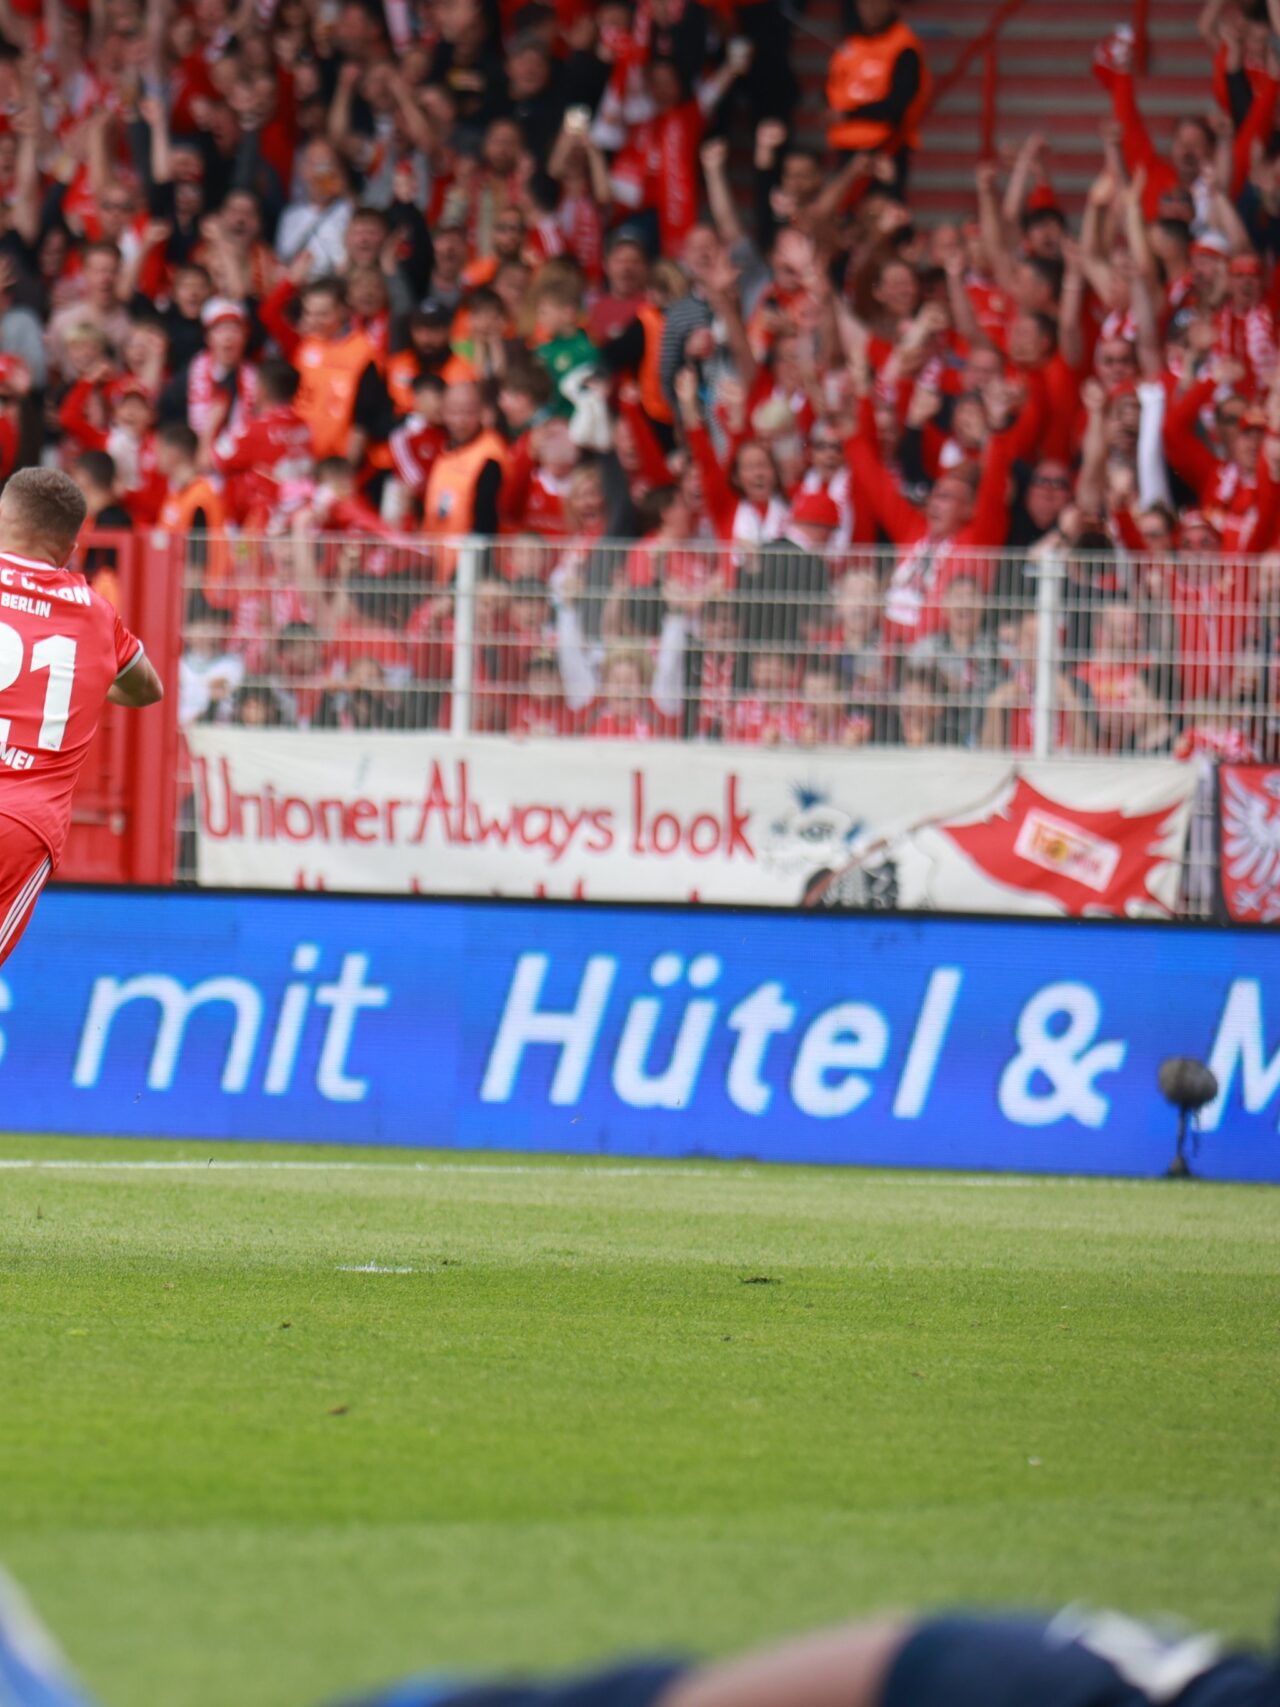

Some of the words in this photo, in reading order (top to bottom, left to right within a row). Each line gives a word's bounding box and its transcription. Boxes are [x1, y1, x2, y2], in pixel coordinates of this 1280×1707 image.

[0, 591, 52, 619] BERLIN
[20, 571, 92, 607] UON
[197, 754, 400, 842] Unioner
[410, 758, 614, 864] Always
[631, 769, 756, 859] look
[71, 942, 388, 1103] mit
[478, 951, 963, 1120] Hütel
[998, 979, 1127, 1129] &
